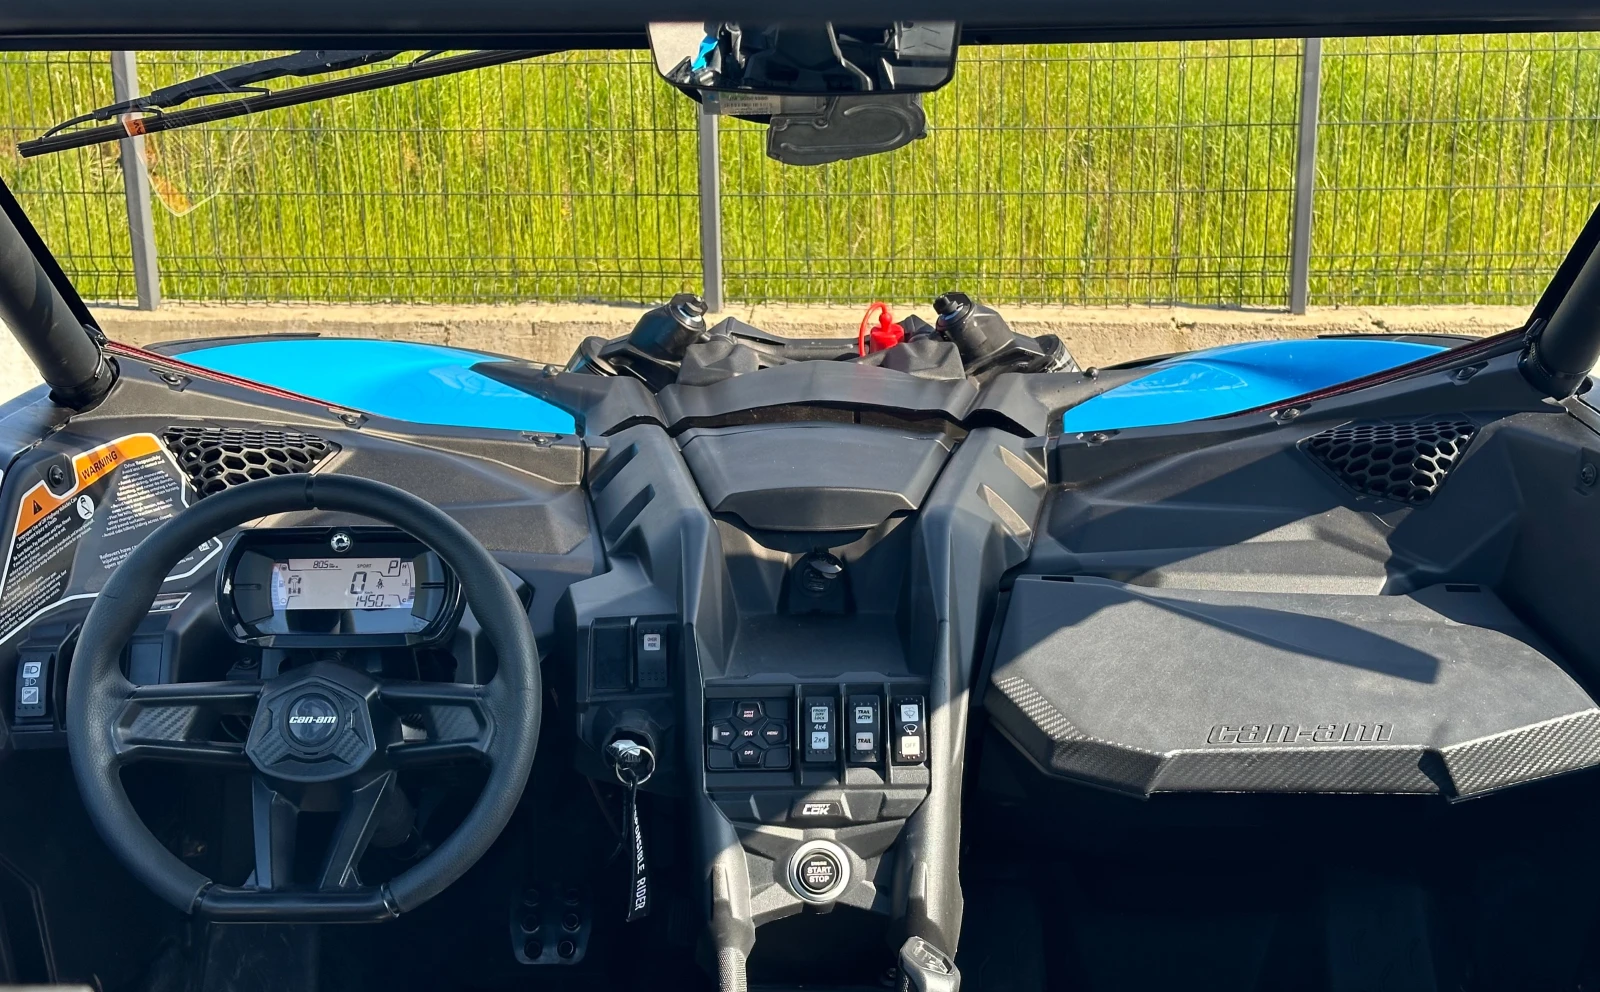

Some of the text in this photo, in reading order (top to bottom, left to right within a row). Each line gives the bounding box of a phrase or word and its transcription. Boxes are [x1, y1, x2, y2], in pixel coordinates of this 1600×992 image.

[82, 451, 118, 480] WARNING
[388, 560, 399, 574] P
[350, 571, 368, 594] 0
[356, 594, 384, 608] 1450
[634, 876, 646, 910] RIDER
